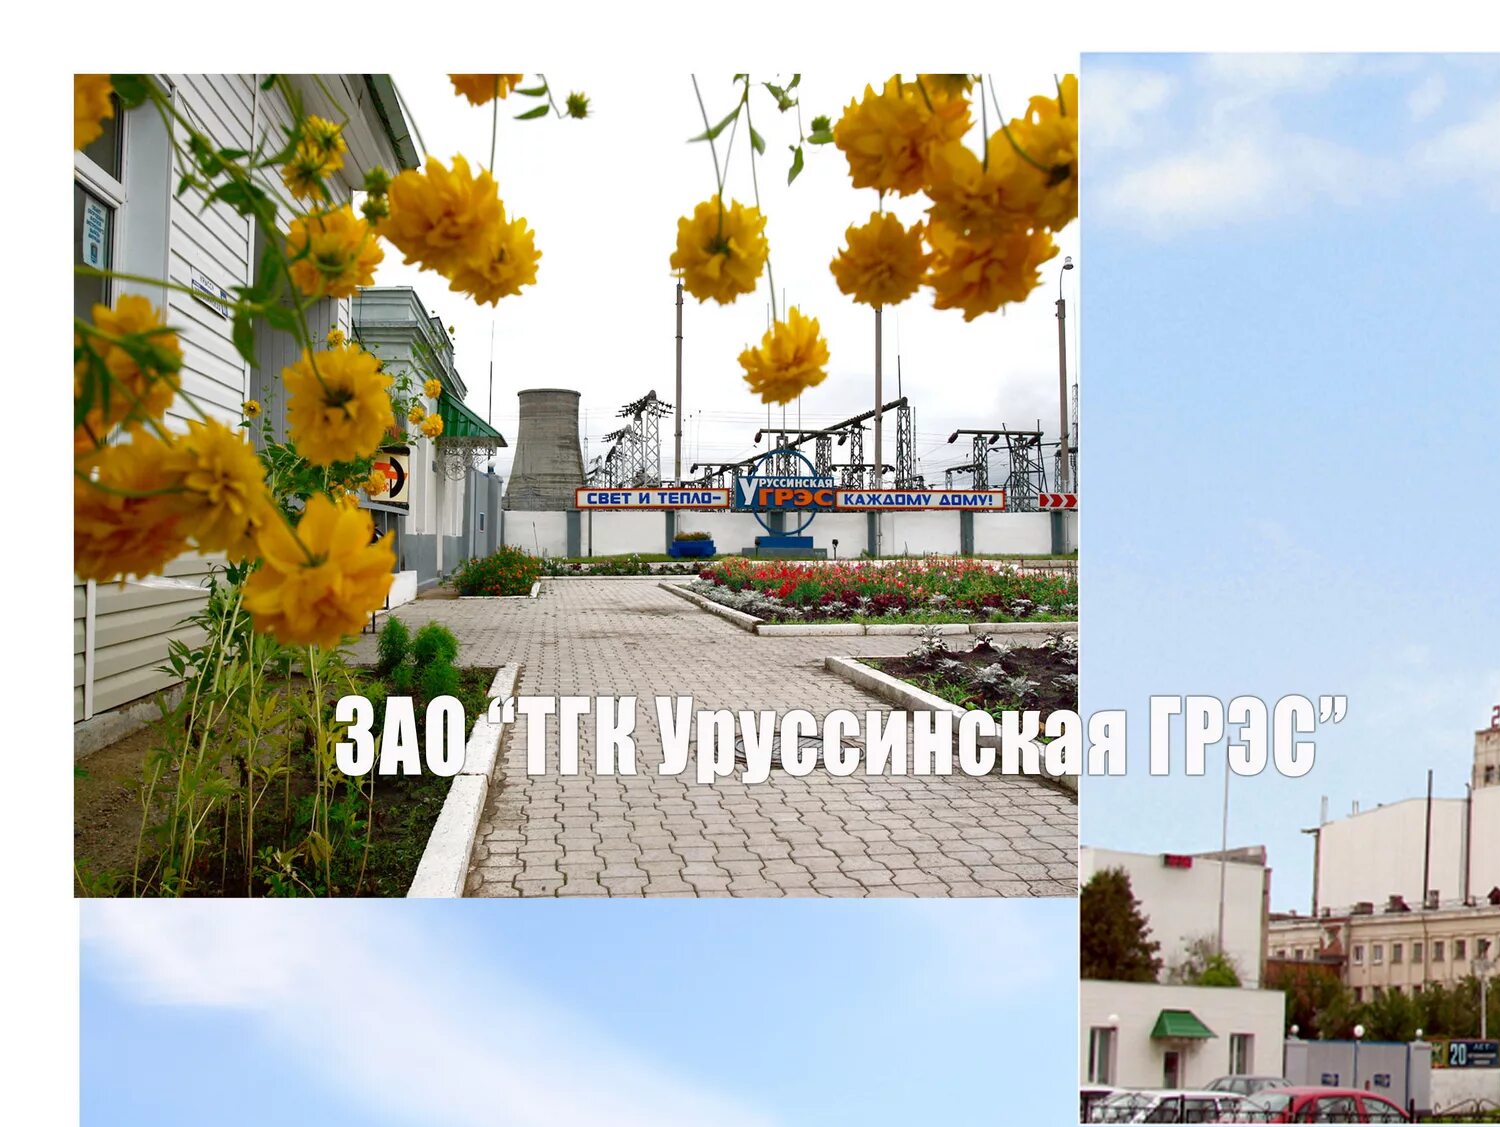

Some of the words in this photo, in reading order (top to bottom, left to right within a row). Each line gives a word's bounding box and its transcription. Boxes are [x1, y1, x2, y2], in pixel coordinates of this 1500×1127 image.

[587, 492, 632, 505] СВЕТ
[639, 492, 650, 504] И
[657, 492, 721, 505] ТЕПЛО-
[738, 478, 833, 506] УРУССИНСКАЯ
[758, 488, 833, 507] ГРЭС
[844, 493, 931, 506] КАЖДОМУ
[939, 494, 993, 506] ДОМУ!
[1450, 1043, 1467, 1066] 20
